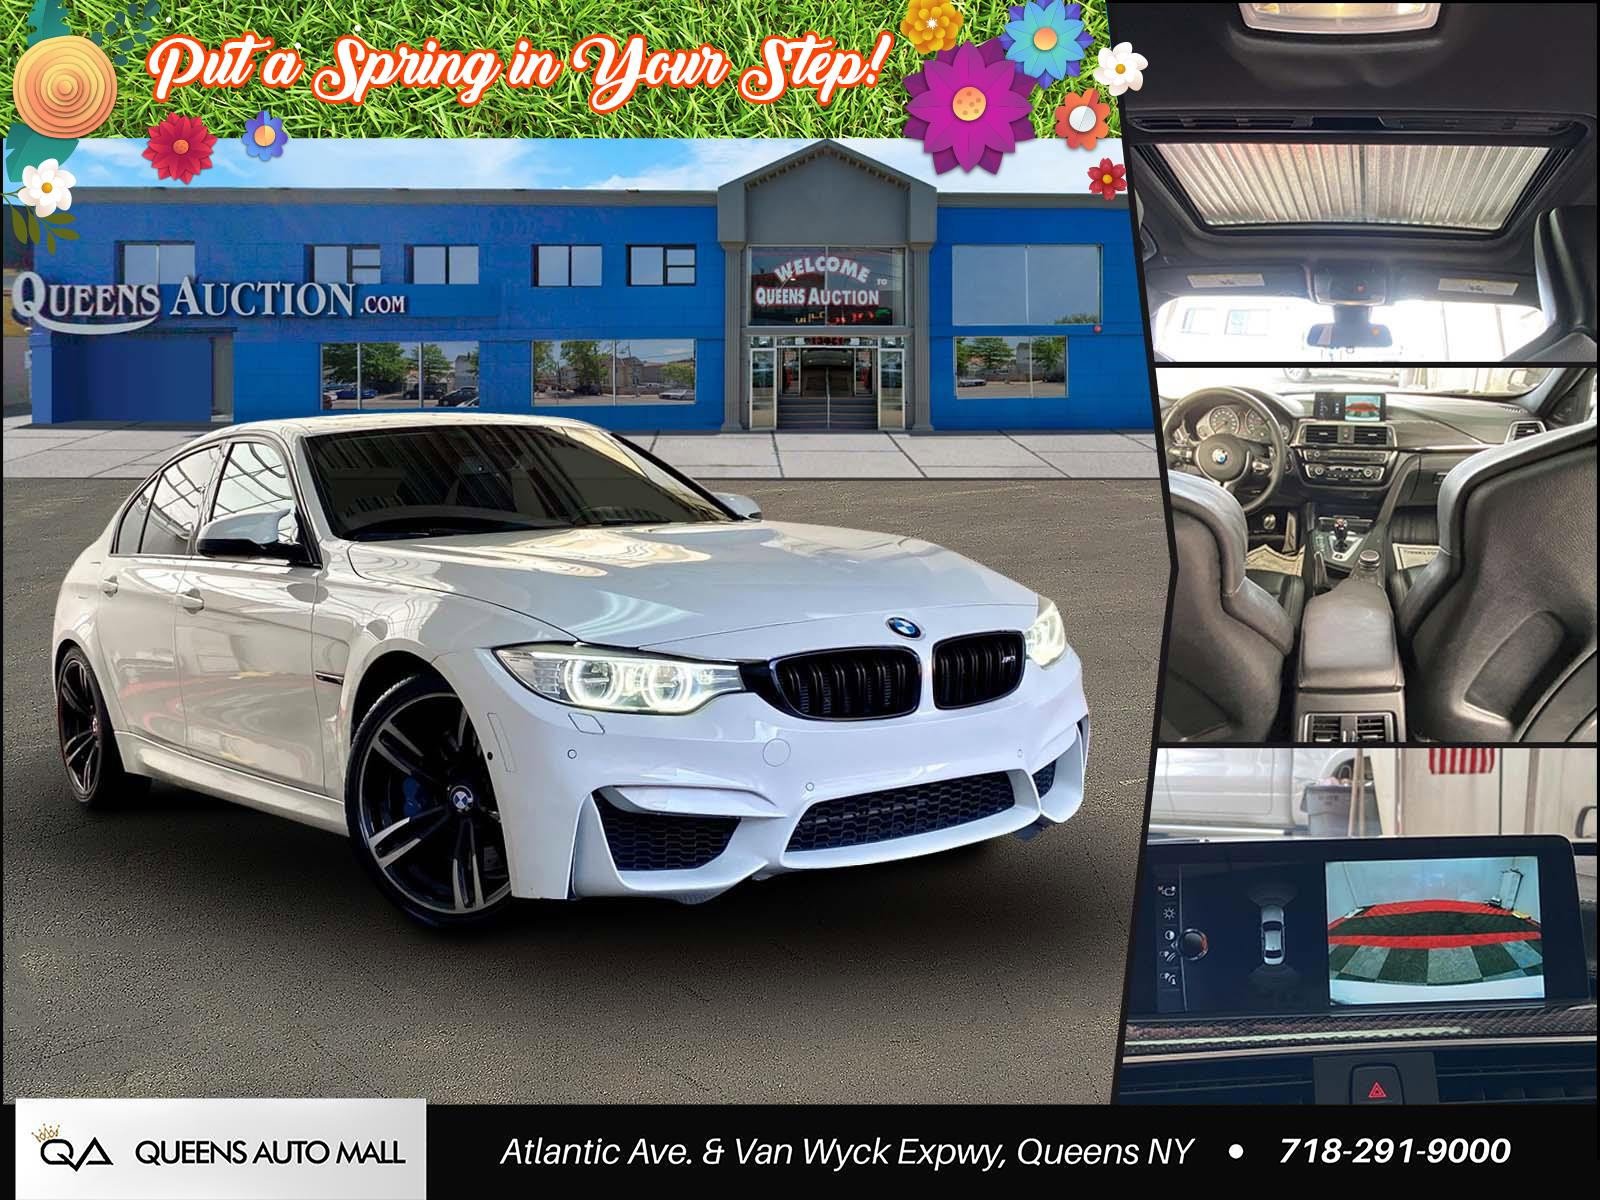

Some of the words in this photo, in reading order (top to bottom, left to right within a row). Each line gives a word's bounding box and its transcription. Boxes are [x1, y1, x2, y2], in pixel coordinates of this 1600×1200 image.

[774, 256, 871, 283] WELCOME
[12, 271, 160, 335] QUEENS
[170, 276, 355, 317] AUCTION
[359, 296, 406, 313] .COM
[755, 287, 806, 306] QUEENS
[808, 287, 880, 305] AUCTION
